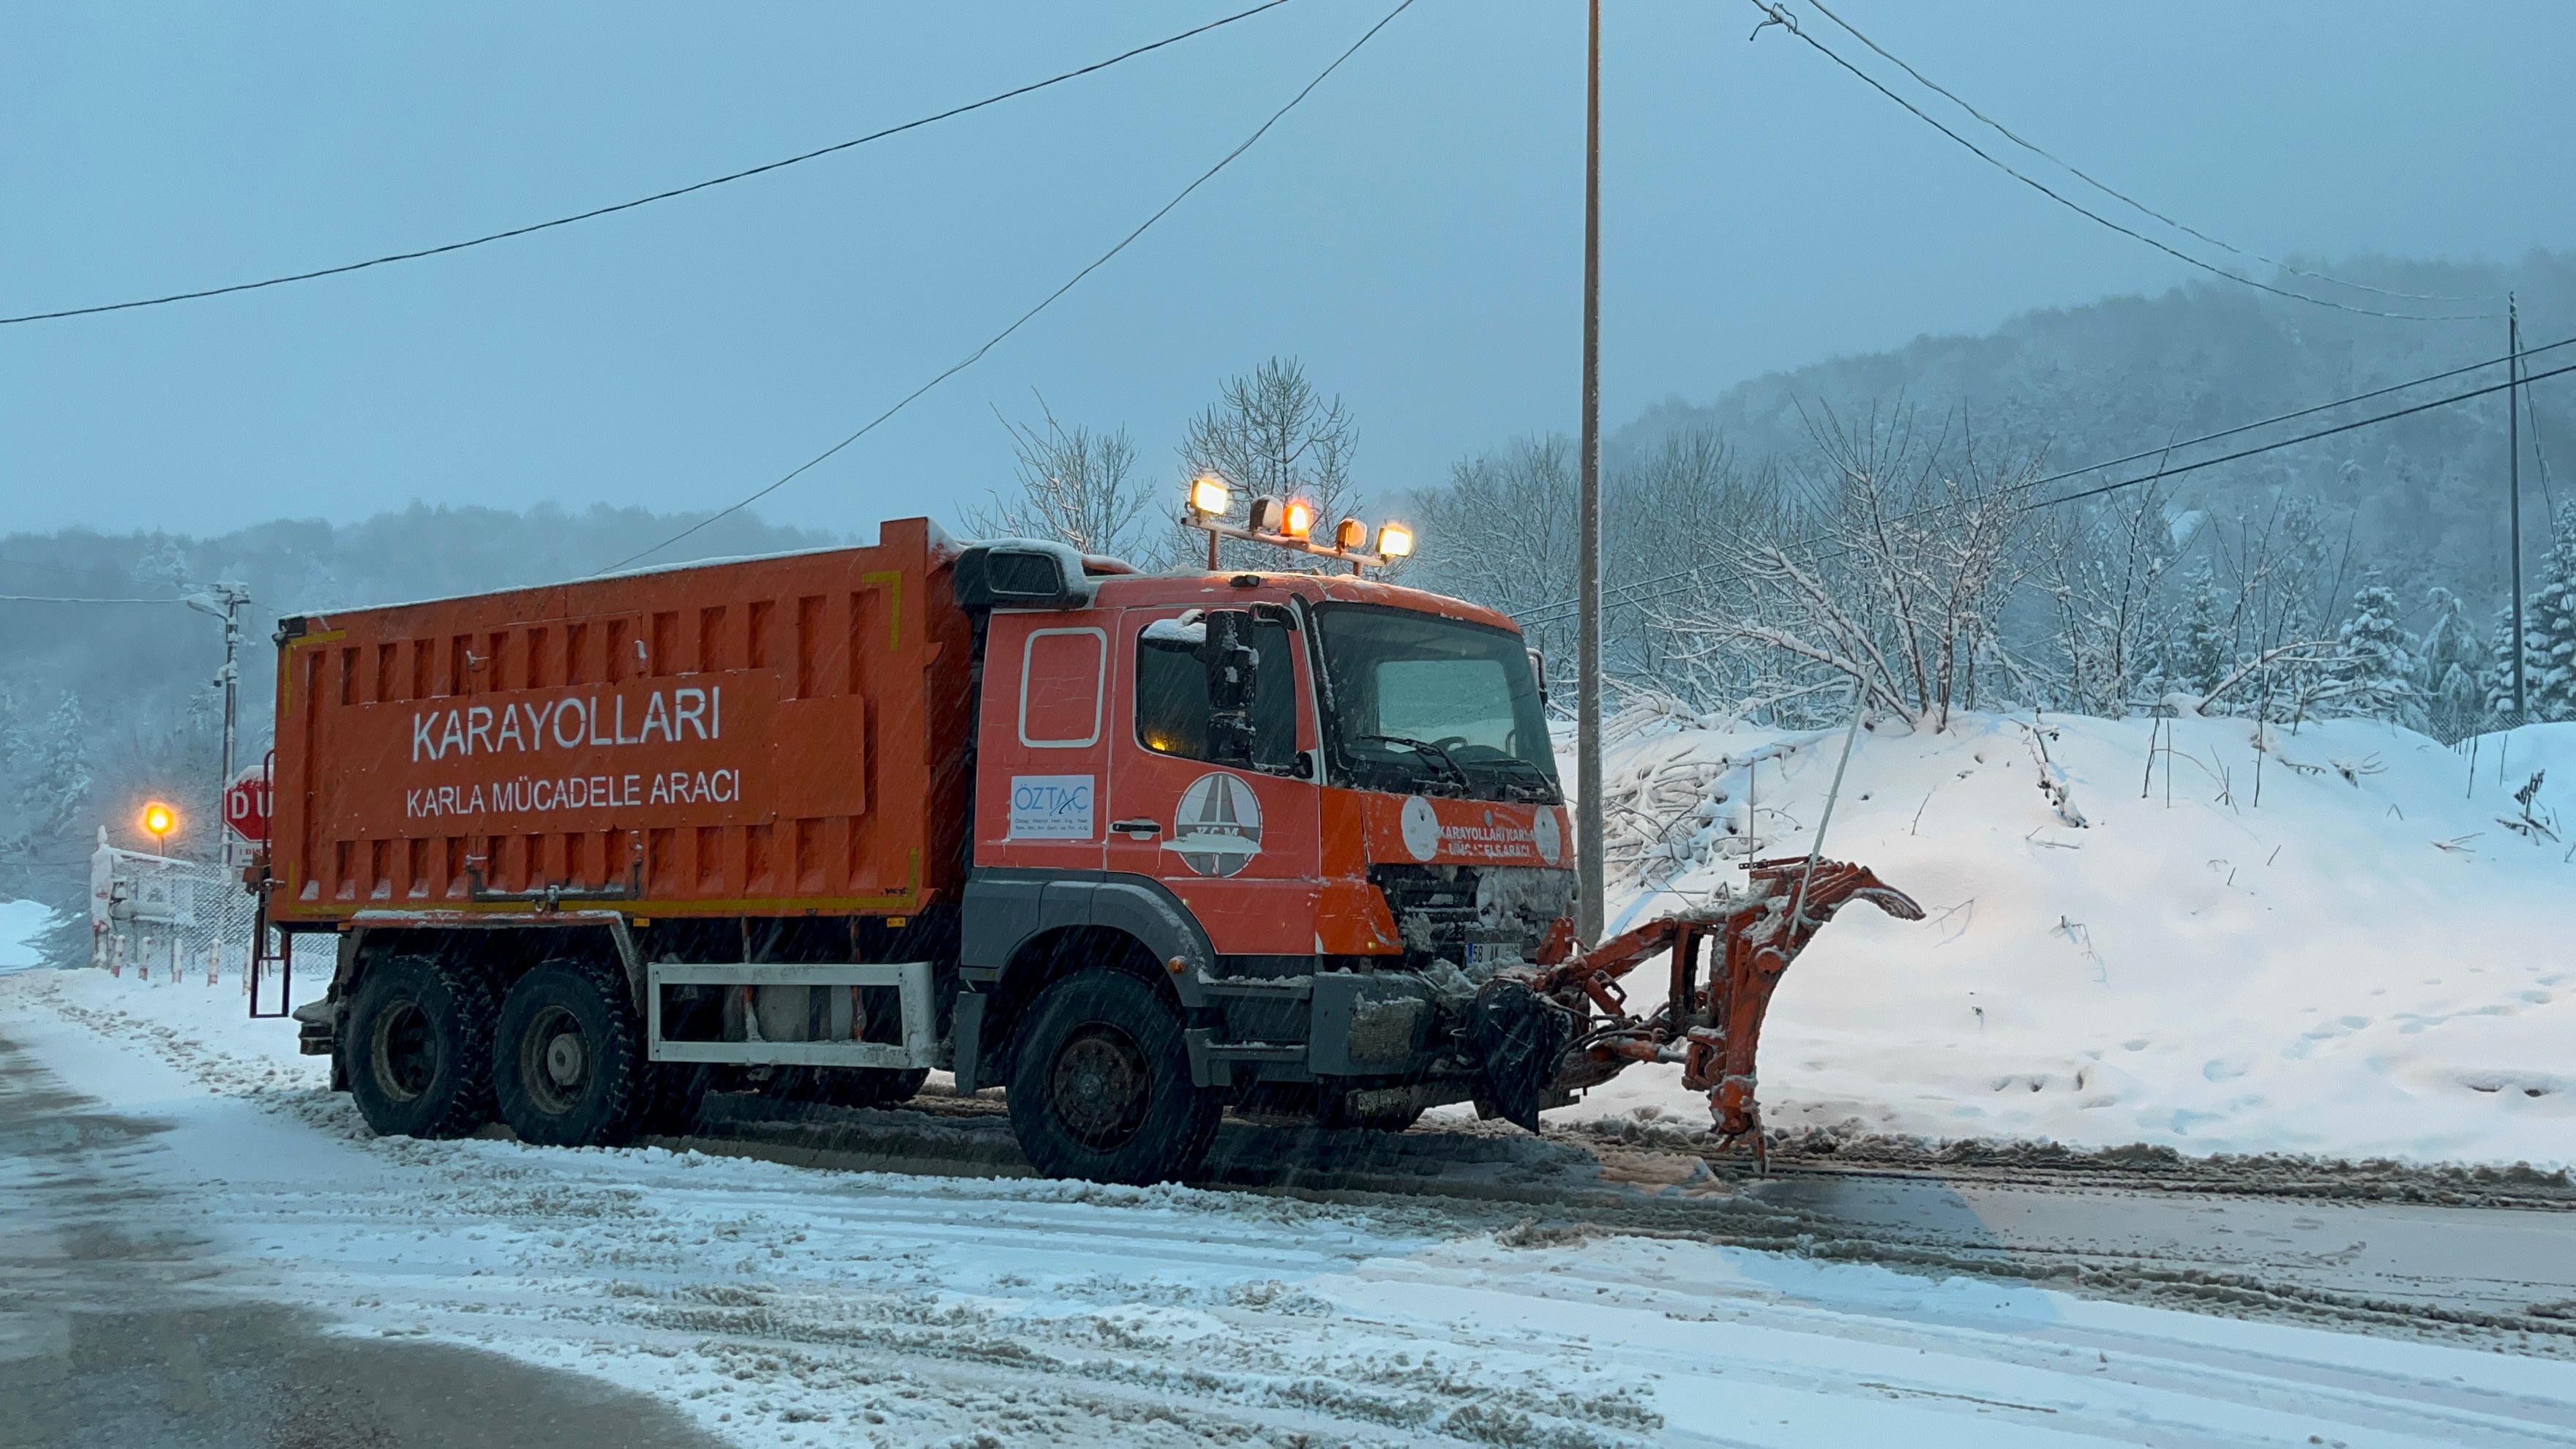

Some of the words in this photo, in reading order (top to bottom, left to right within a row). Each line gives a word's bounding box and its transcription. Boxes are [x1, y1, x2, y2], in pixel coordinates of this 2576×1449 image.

[412, 686, 719, 762] KARAYOLLARI
[407, 785, 485, 817] KARLA
[493, 774, 641, 812] MÜCADELE
[650, 769, 740, 805] ARACI
[1014, 784, 1088, 816] ÖZTAÇ
[1472, 945, 1483, 963] 58
